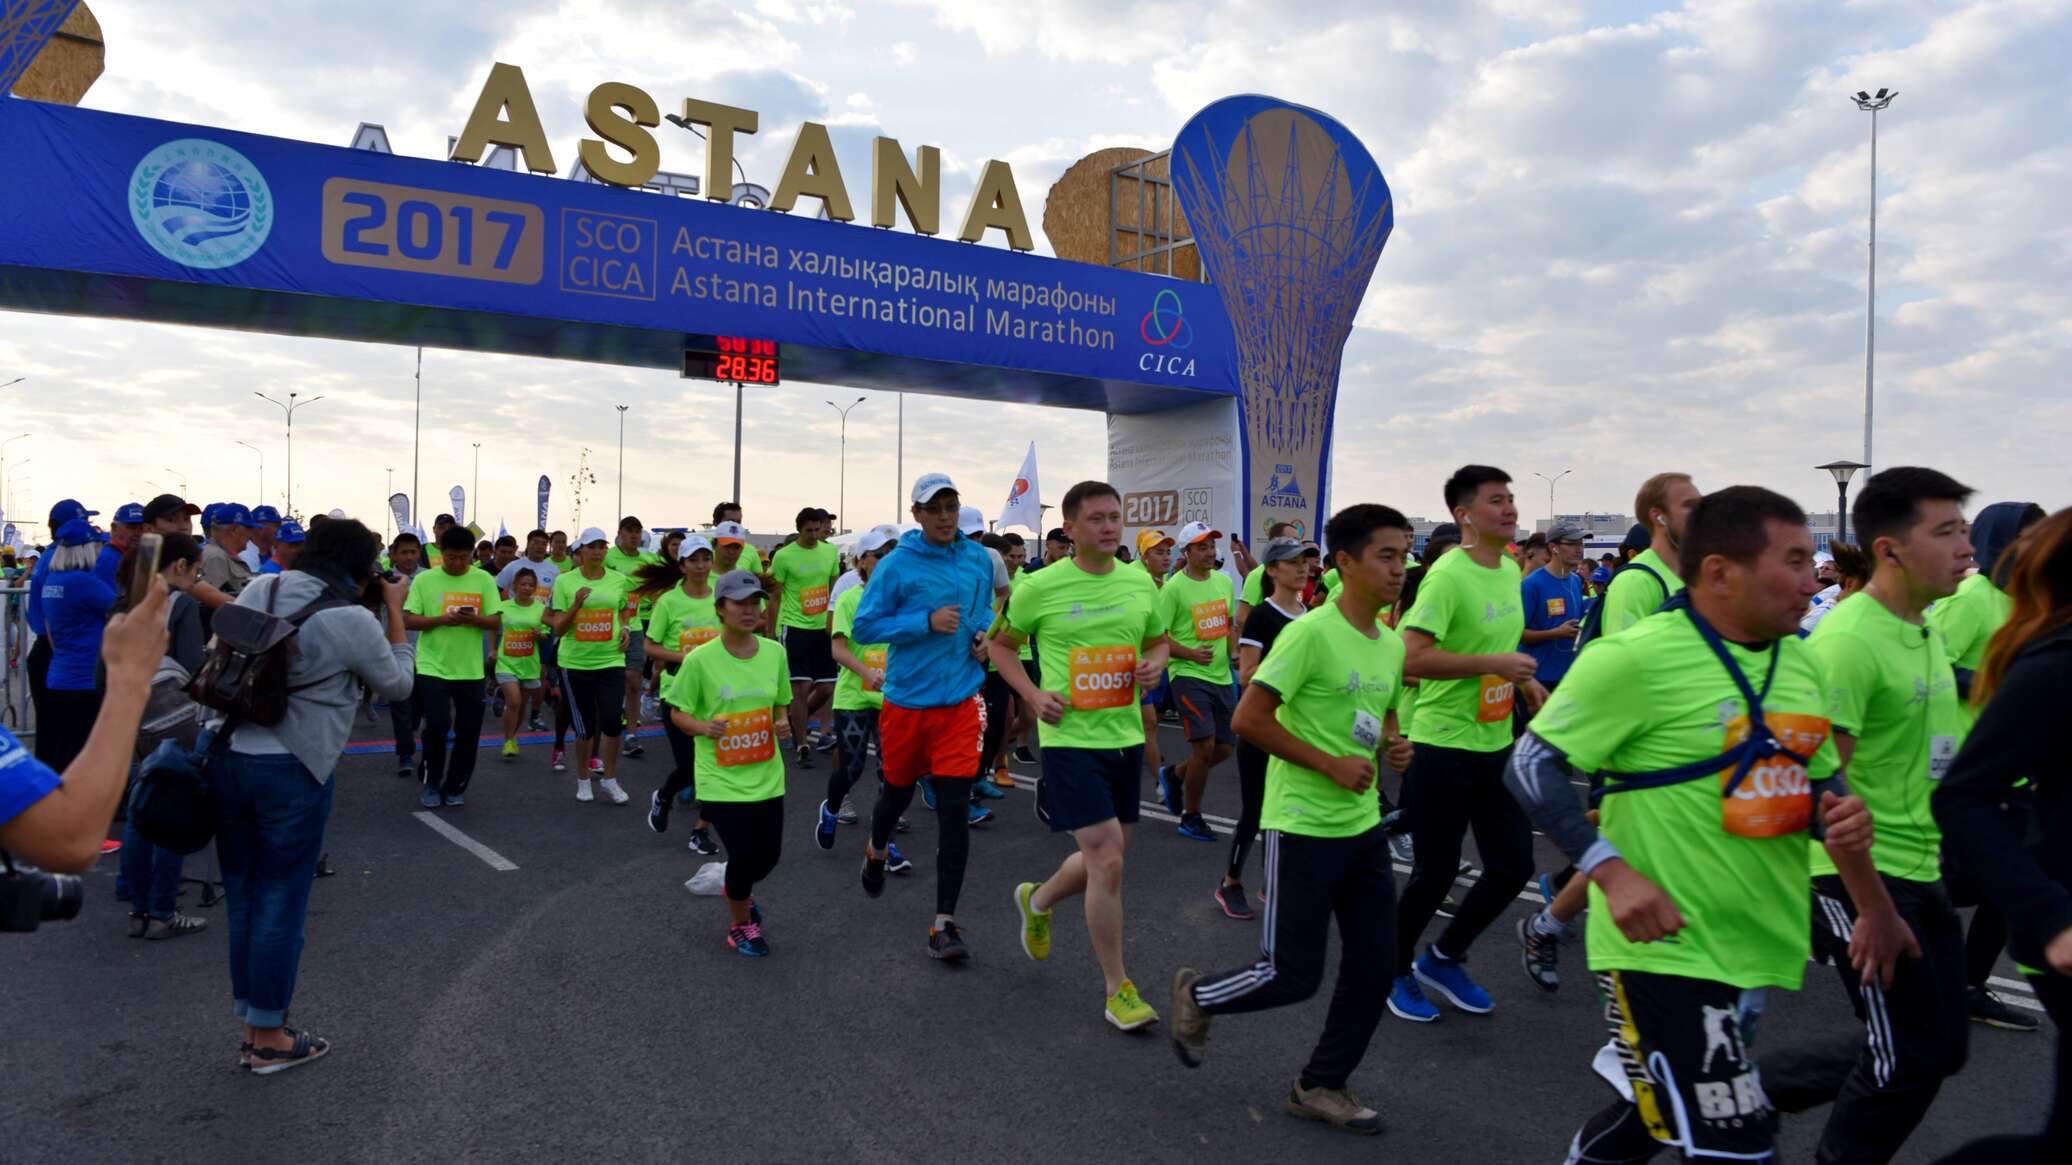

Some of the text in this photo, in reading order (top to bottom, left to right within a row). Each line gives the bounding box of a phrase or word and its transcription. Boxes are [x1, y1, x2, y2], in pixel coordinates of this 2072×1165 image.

[449, 61, 1034, 252] ASTANA
[342, 191, 527, 270] 2017
[575, 216, 641, 254] SCO
[568, 255, 646, 293] CICA
[671, 226, 1116, 316] Астана халықаралық марафоны
[670, 266, 1115, 350] Astana International Marathon
[1138, 352, 1197, 377] CICA
[1127, 495, 1175, 523] 2017
[1186, 490, 1208, 506] SCO
[1261, 494, 1308, 510] ASTANA
[1185, 508, 1209, 523] CICA
[1074, 671, 1133, 691] C0059
[719, 729, 769, 752] C0329
